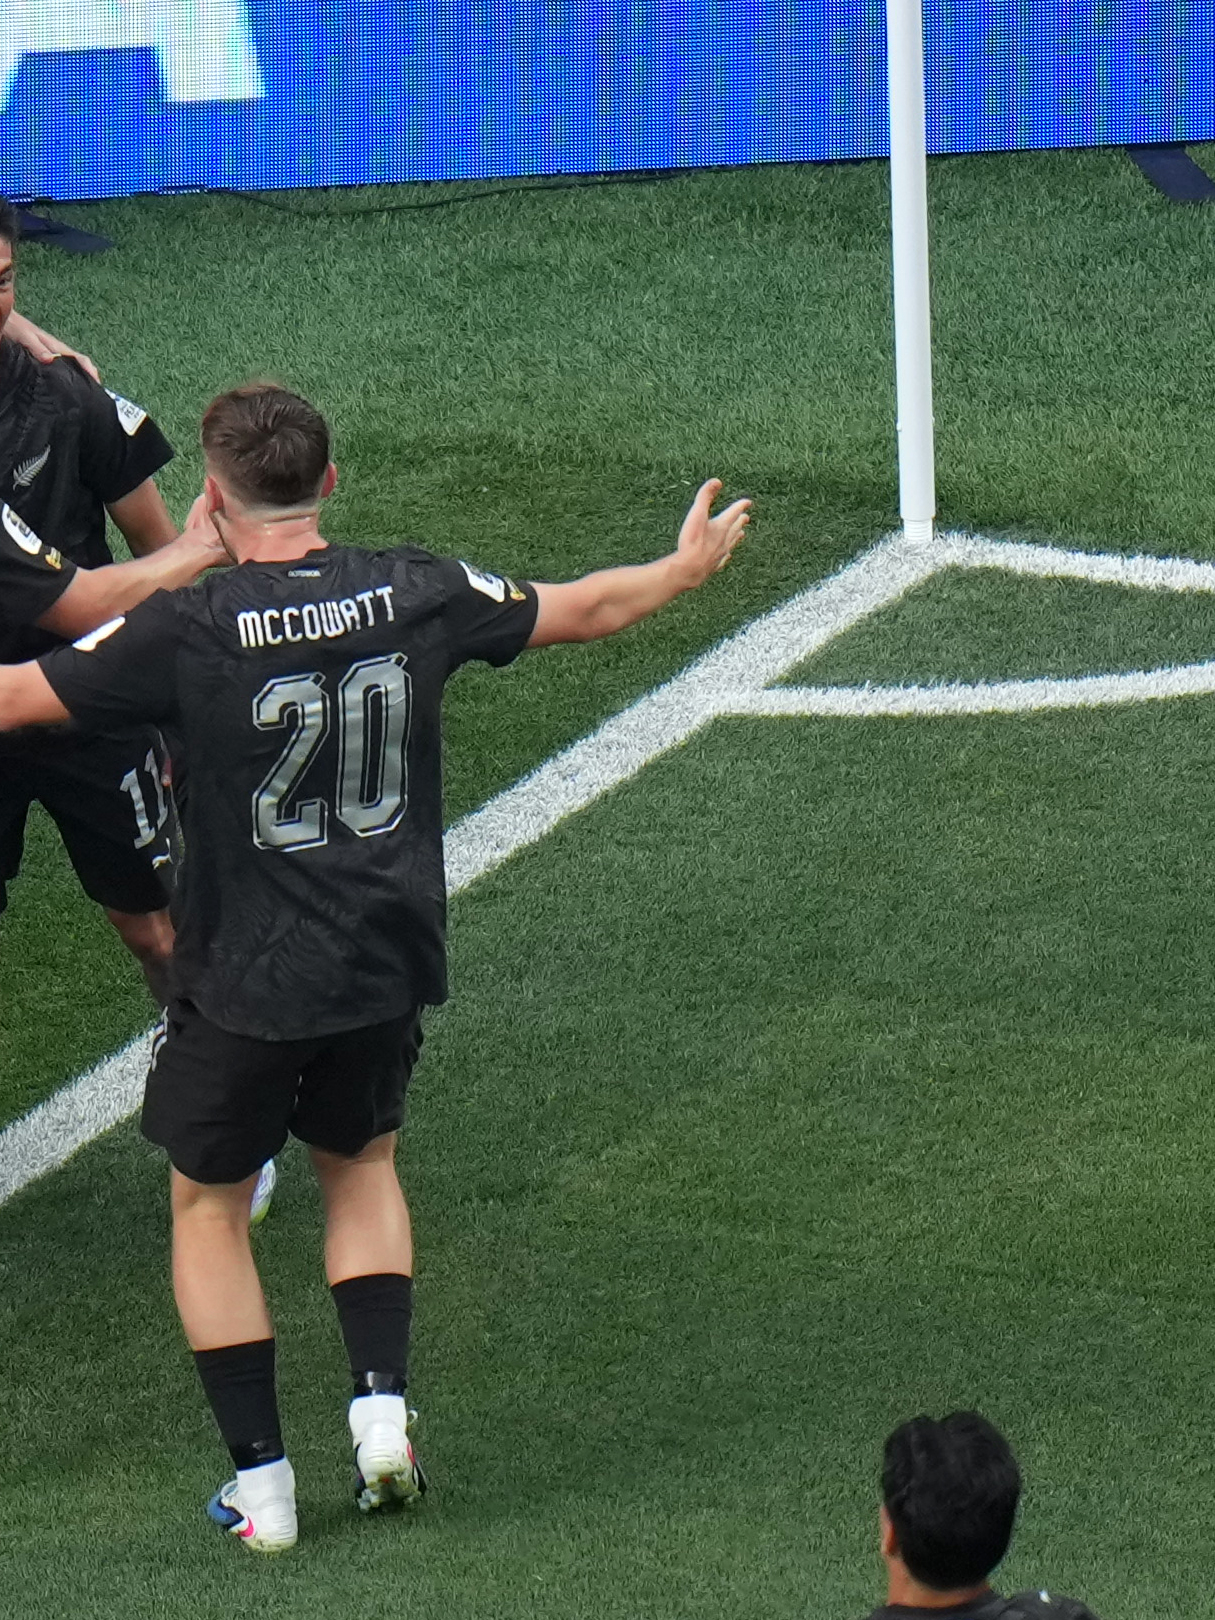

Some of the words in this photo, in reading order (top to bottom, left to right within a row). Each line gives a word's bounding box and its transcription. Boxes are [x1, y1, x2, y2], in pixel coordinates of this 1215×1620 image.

[236, 585, 396, 648] MCCOWATT
[119, 747, 169, 850] 11
[251, 651, 413, 853] 20
